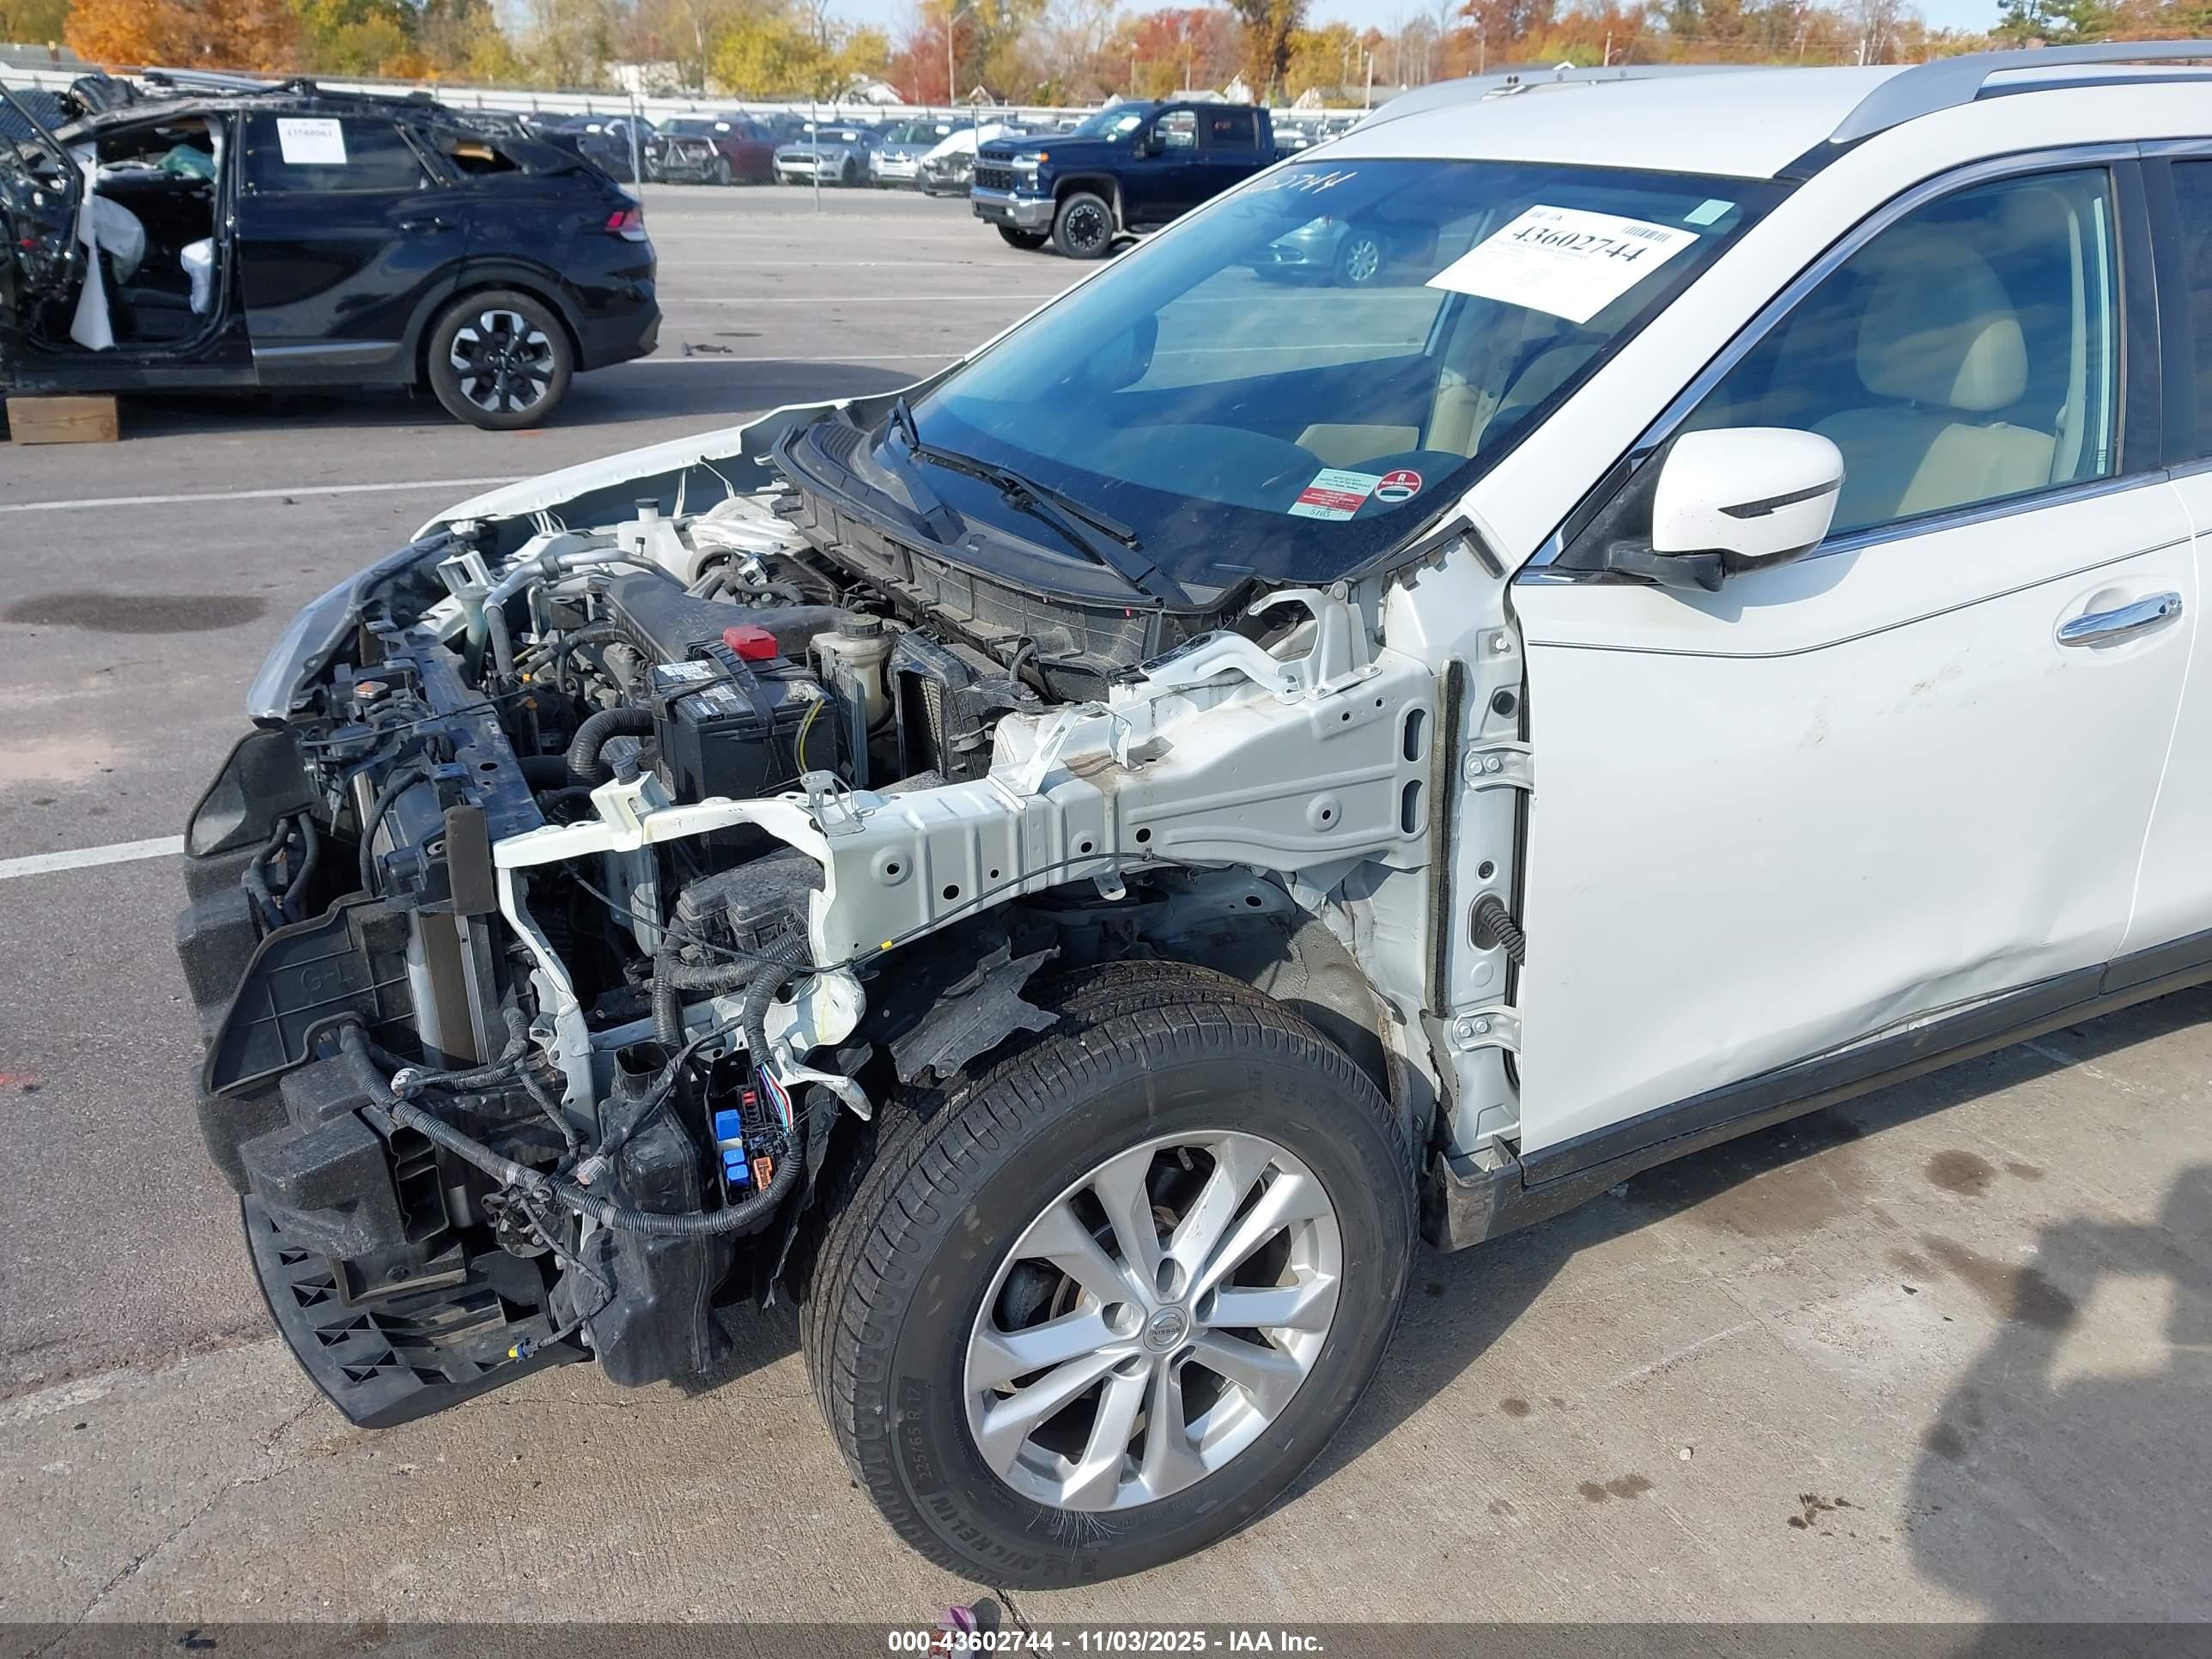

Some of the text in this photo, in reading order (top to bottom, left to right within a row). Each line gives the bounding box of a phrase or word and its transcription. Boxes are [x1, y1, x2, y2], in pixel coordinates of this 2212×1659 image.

[1512, 225, 1649, 262] 43602744
[1152, 1325, 1182, 1336] NISSAN
[906, 1387, 934, 1480] 225/65 R 17
[929, 1495, 1039, 1571] MICHELIN
